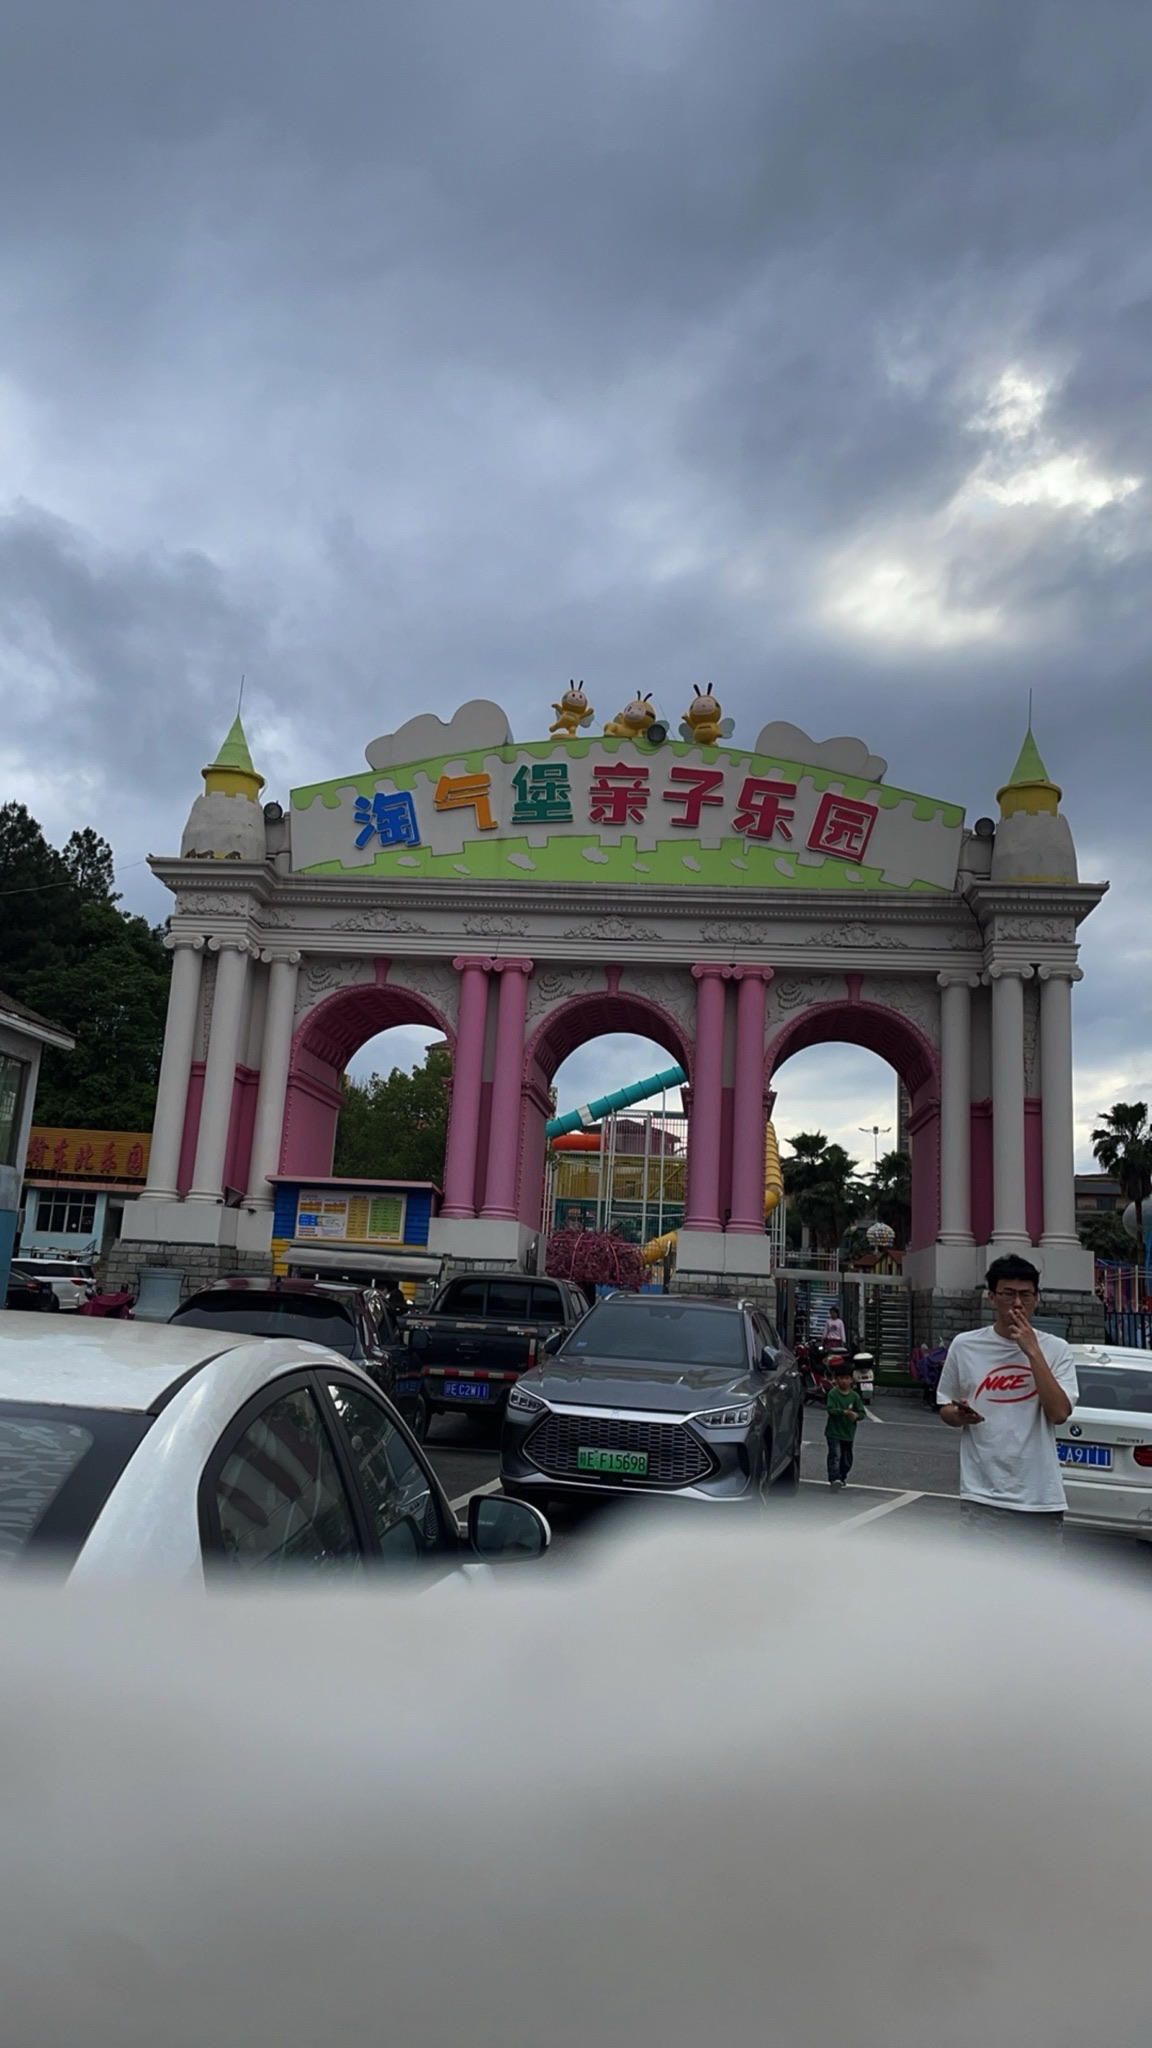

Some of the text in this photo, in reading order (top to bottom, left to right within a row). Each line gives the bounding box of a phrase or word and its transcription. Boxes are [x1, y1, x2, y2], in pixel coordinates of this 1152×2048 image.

[354, 762, 879, 862] 淘气堡亲子乐园
[974, 1373, 1032, 1400] NICE
